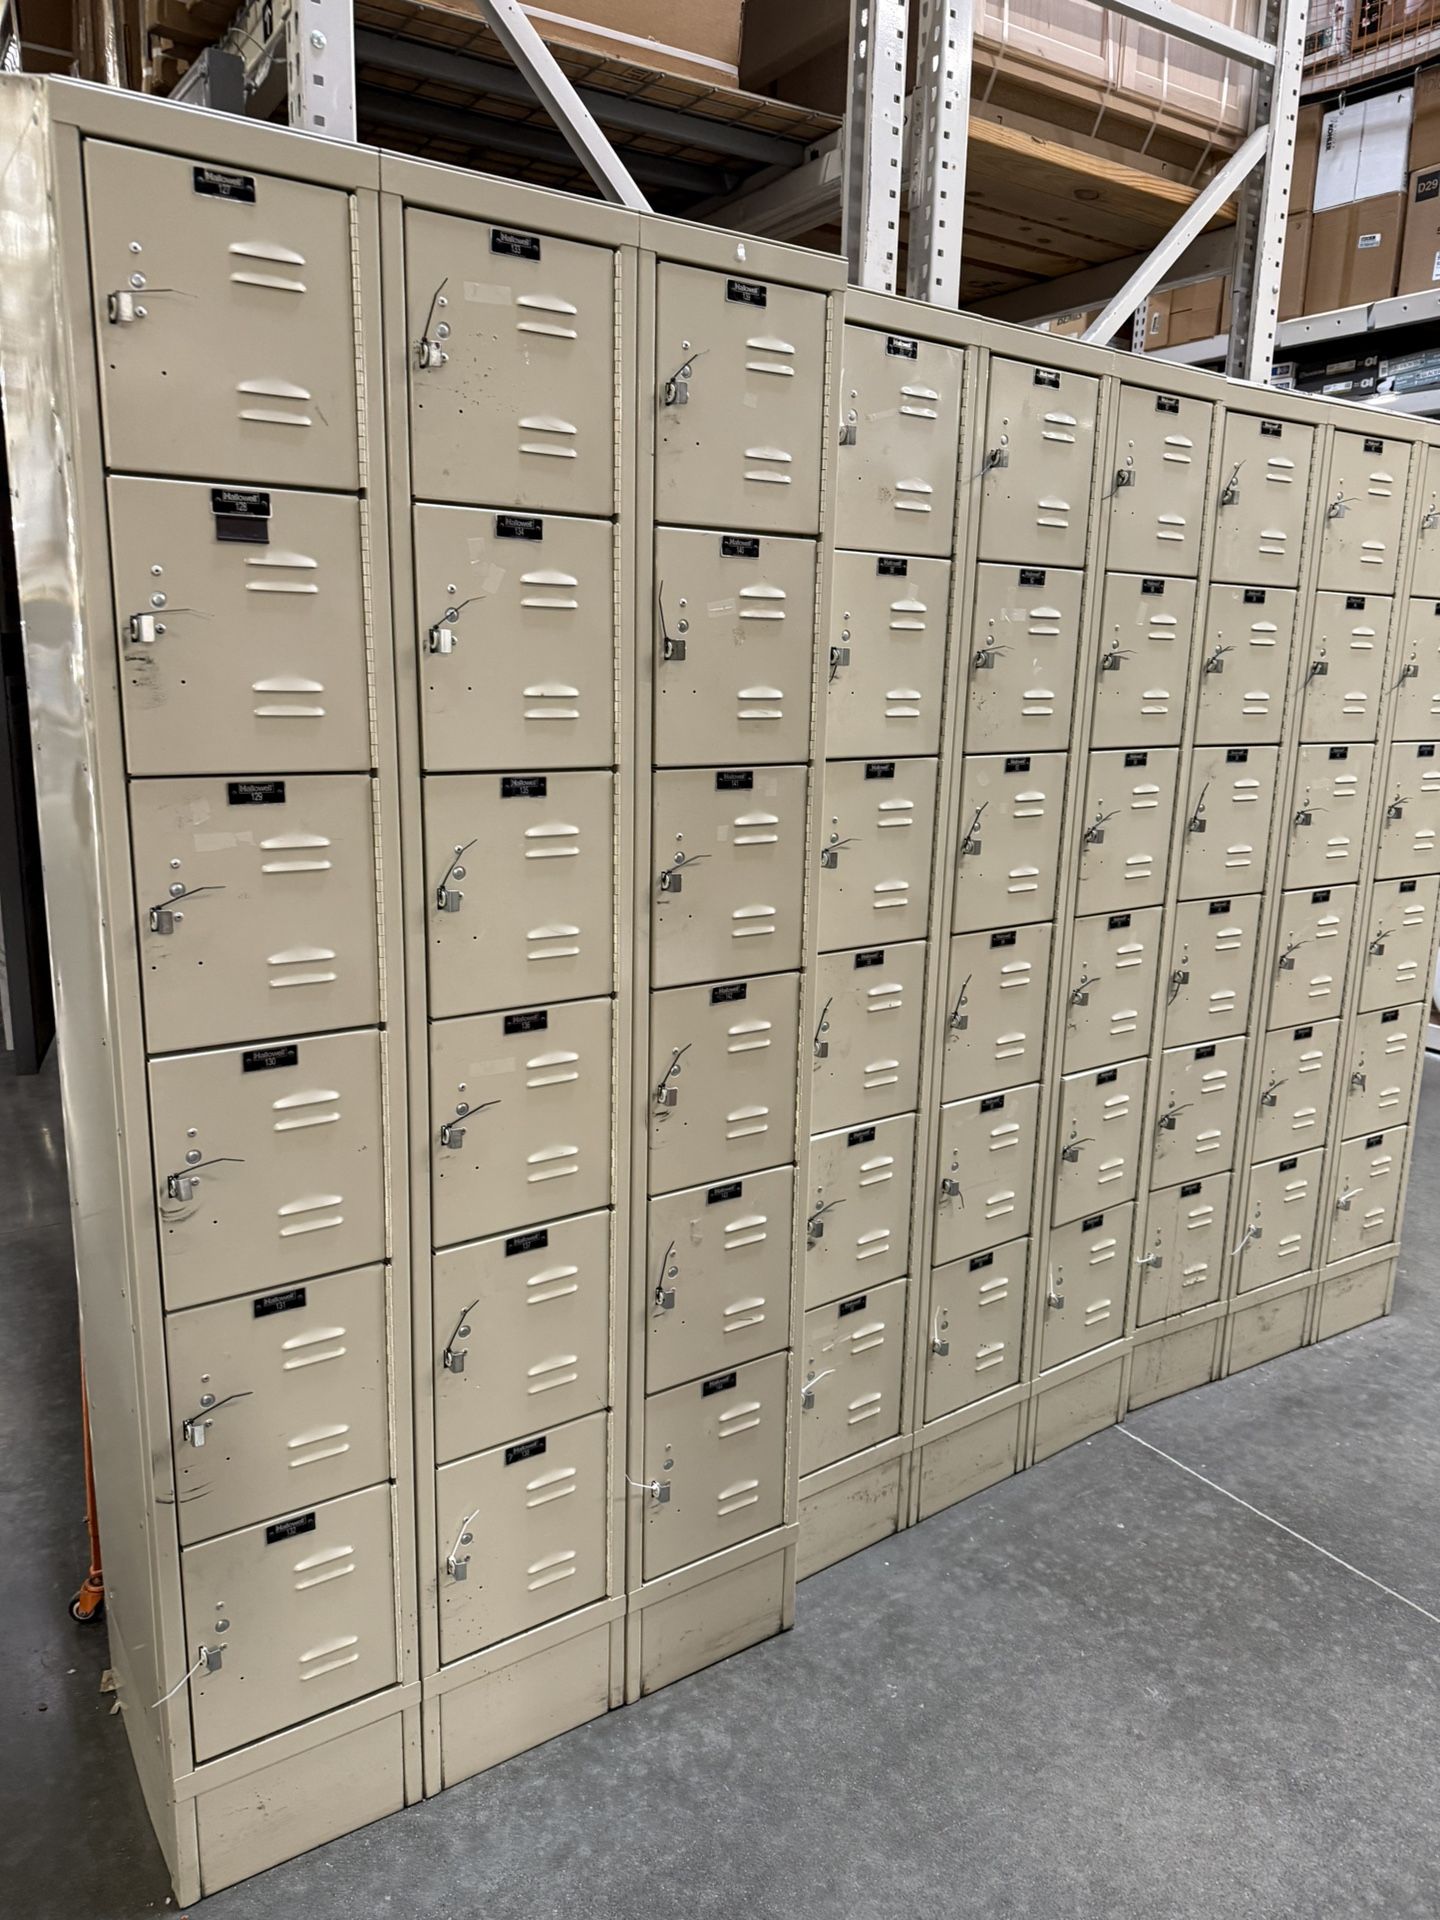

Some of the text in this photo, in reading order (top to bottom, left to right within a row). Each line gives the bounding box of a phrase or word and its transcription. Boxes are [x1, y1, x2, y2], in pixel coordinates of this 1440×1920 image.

[205, 169, 242, 186] Hallowell
[218, 183, 231, 195] 127
[1418, 178, 1438, 193] D29
[500, 232, 530, 246] Hallowell
[511, 244, 521, 254] 133
[223, 491, 258, 503] Hallowell
[236, 501, 248, 512] 128
[505, 518, 533, 528] Hallowell
[515, 527, 524, 536] 134
[239, 784, 273, 792] Hallowell
[520, 786, 529, 794] 135
[251, 792, 263, 801] 129
[253, 1050, 285, 1061] Hallowell
[265, 1057, 276, 1066] 130
[523, 1241, 531, 1249] 137
[263, 1292, 295, 1306] Hallowell
[276, 1301, 286, 1310] 131
[275, 1518, 305, 1532] Hallowell
[286, 1526, 297, 1535] 132
